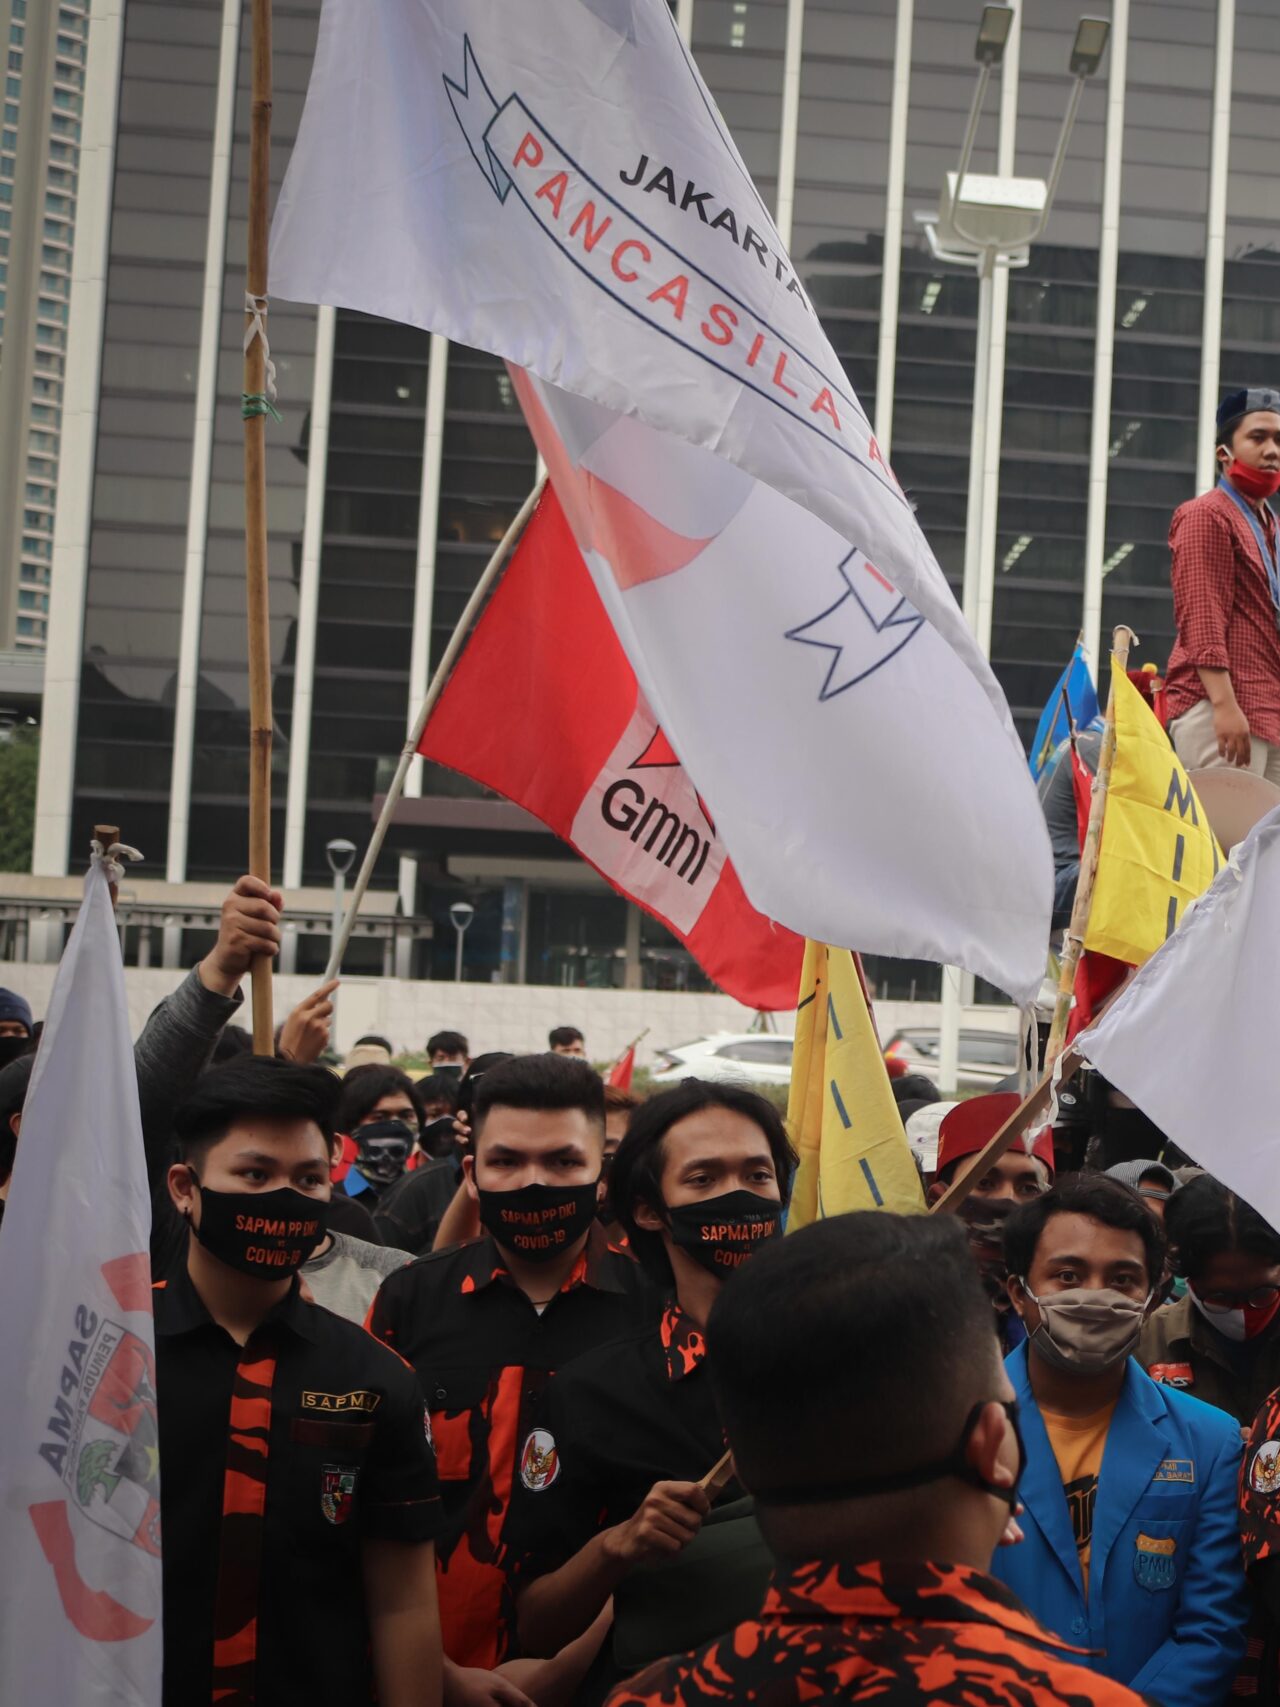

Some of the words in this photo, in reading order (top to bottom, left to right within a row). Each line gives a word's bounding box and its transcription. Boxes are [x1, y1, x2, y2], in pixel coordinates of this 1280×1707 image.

[619, 155, 809, 312] JAKARTA
[512, 132, 841, 431] PANCASILA
[236, 1215, 286, 1236] SAPMA
[288, 1221, 302, 1237] PP
[501, 1209, 540, 1225] SAPMA
[542, 1208, 557, 1222] PP
[514, 1229, 566, 1249] COVID-19
[701, 1225, 749, 1240] SAPMA
[751, 1223, 764, 1239] PP
[246, 1247, 302, 1266] COVID-19
[306, 1394, 371, 1408] SAPM
[1139, 1554, 1172, 1573] PMII
